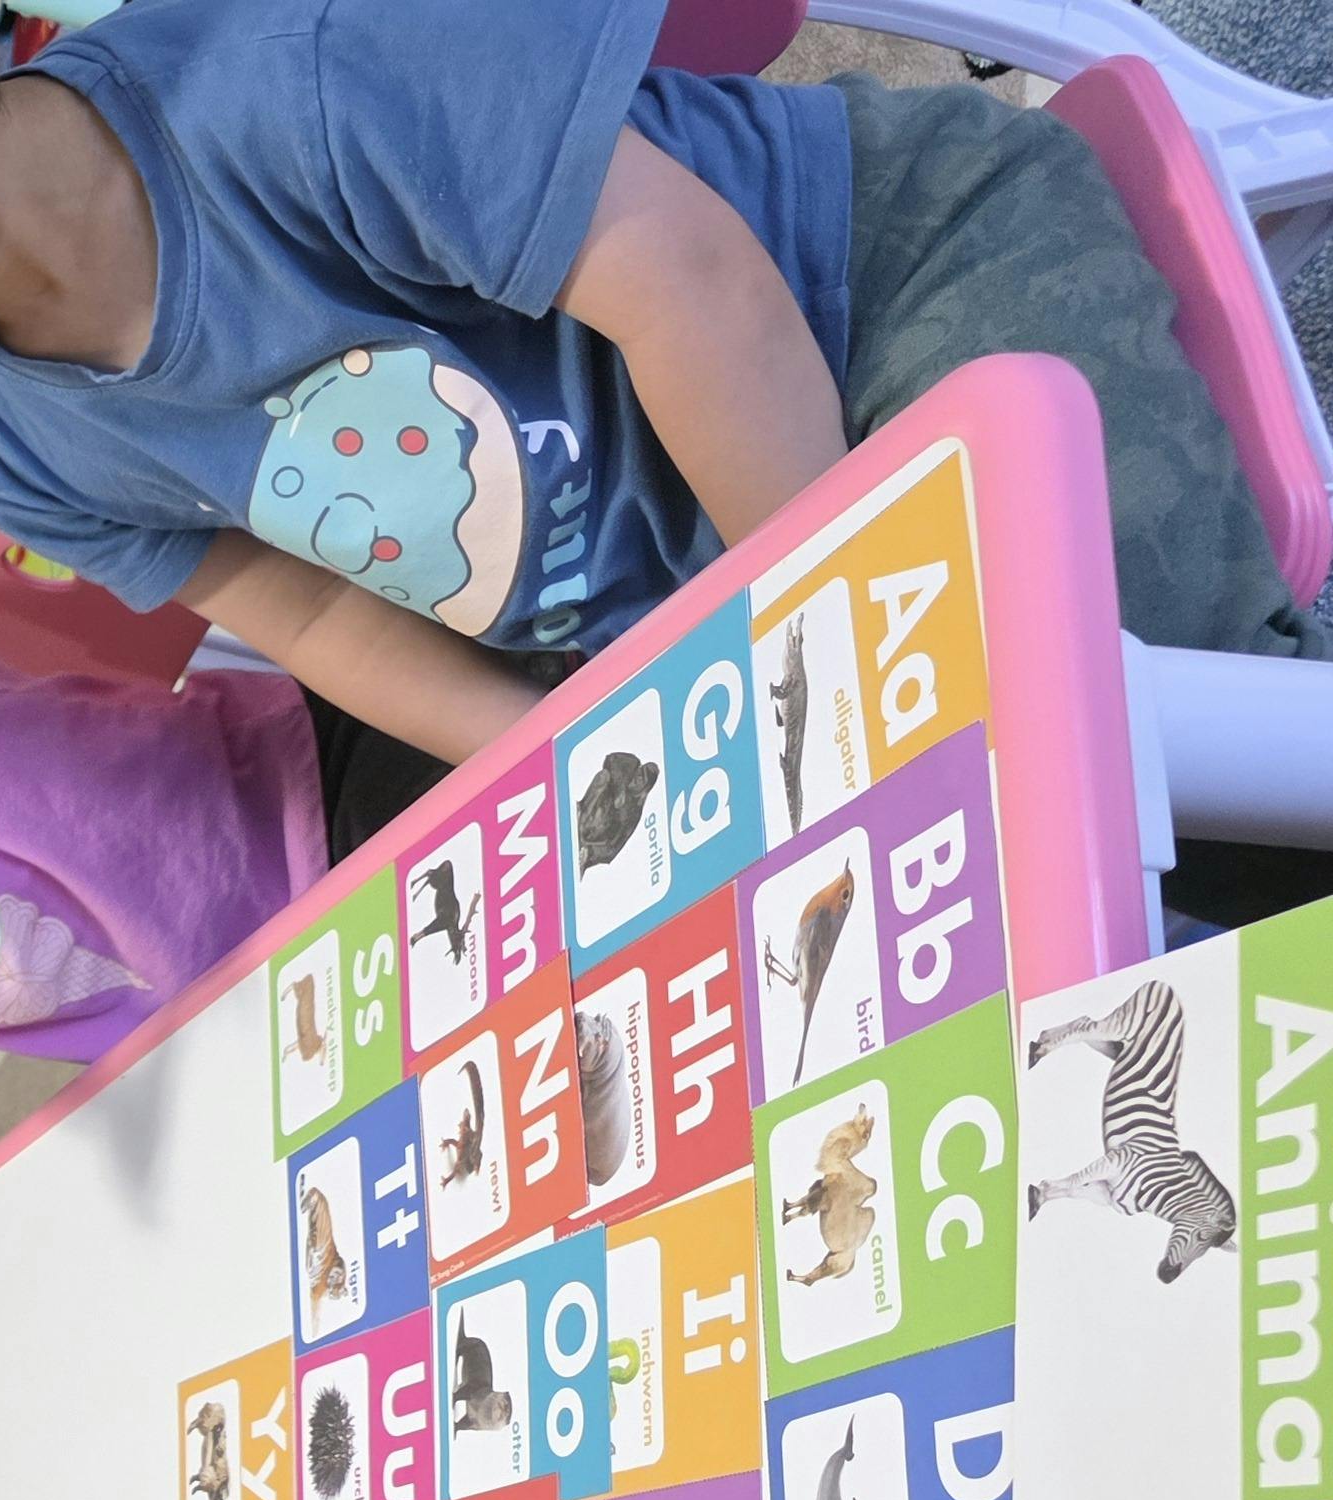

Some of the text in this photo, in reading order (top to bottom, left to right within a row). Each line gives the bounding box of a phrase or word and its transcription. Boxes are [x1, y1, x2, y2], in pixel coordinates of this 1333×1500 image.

[531, 466, 593, 649] onut
[866, 559, 948, 747] Aa
[671, 660, 742, 856] Gg
[831, 688, 858, 790] alligator
[496, 781, 548, 991] Mm
[642, 812, 666, 887] gorilla
[887, 809, 969, 1005] Bb
[351, 932, 394, 1047] Ss
[465, 932, 480, 1002] moose
[853, 998, 877, 1054] bird
[322, 966, 341, 1093] sneaky sheep
[624, 1001, 649, 1170] hippopotamus
[666, 948, 736, 1136] Hh
[513, 1012, 570, 1186] Nn
[372, 1143, 420, 1249] Tt
[487, 1161, 504, 1215] newt
[918, 1093, 1004, 1262] Cc
[345, 1260, 361, 1305] tiger
[682, 1273, 746, 1376] Ii
[868, 1233, 892, 1314] camel
[543, 1281, 598, 1458] Oo
[640, 1327, 655, 1448] inchworm
[509, 1420, 524, 1474] otter
